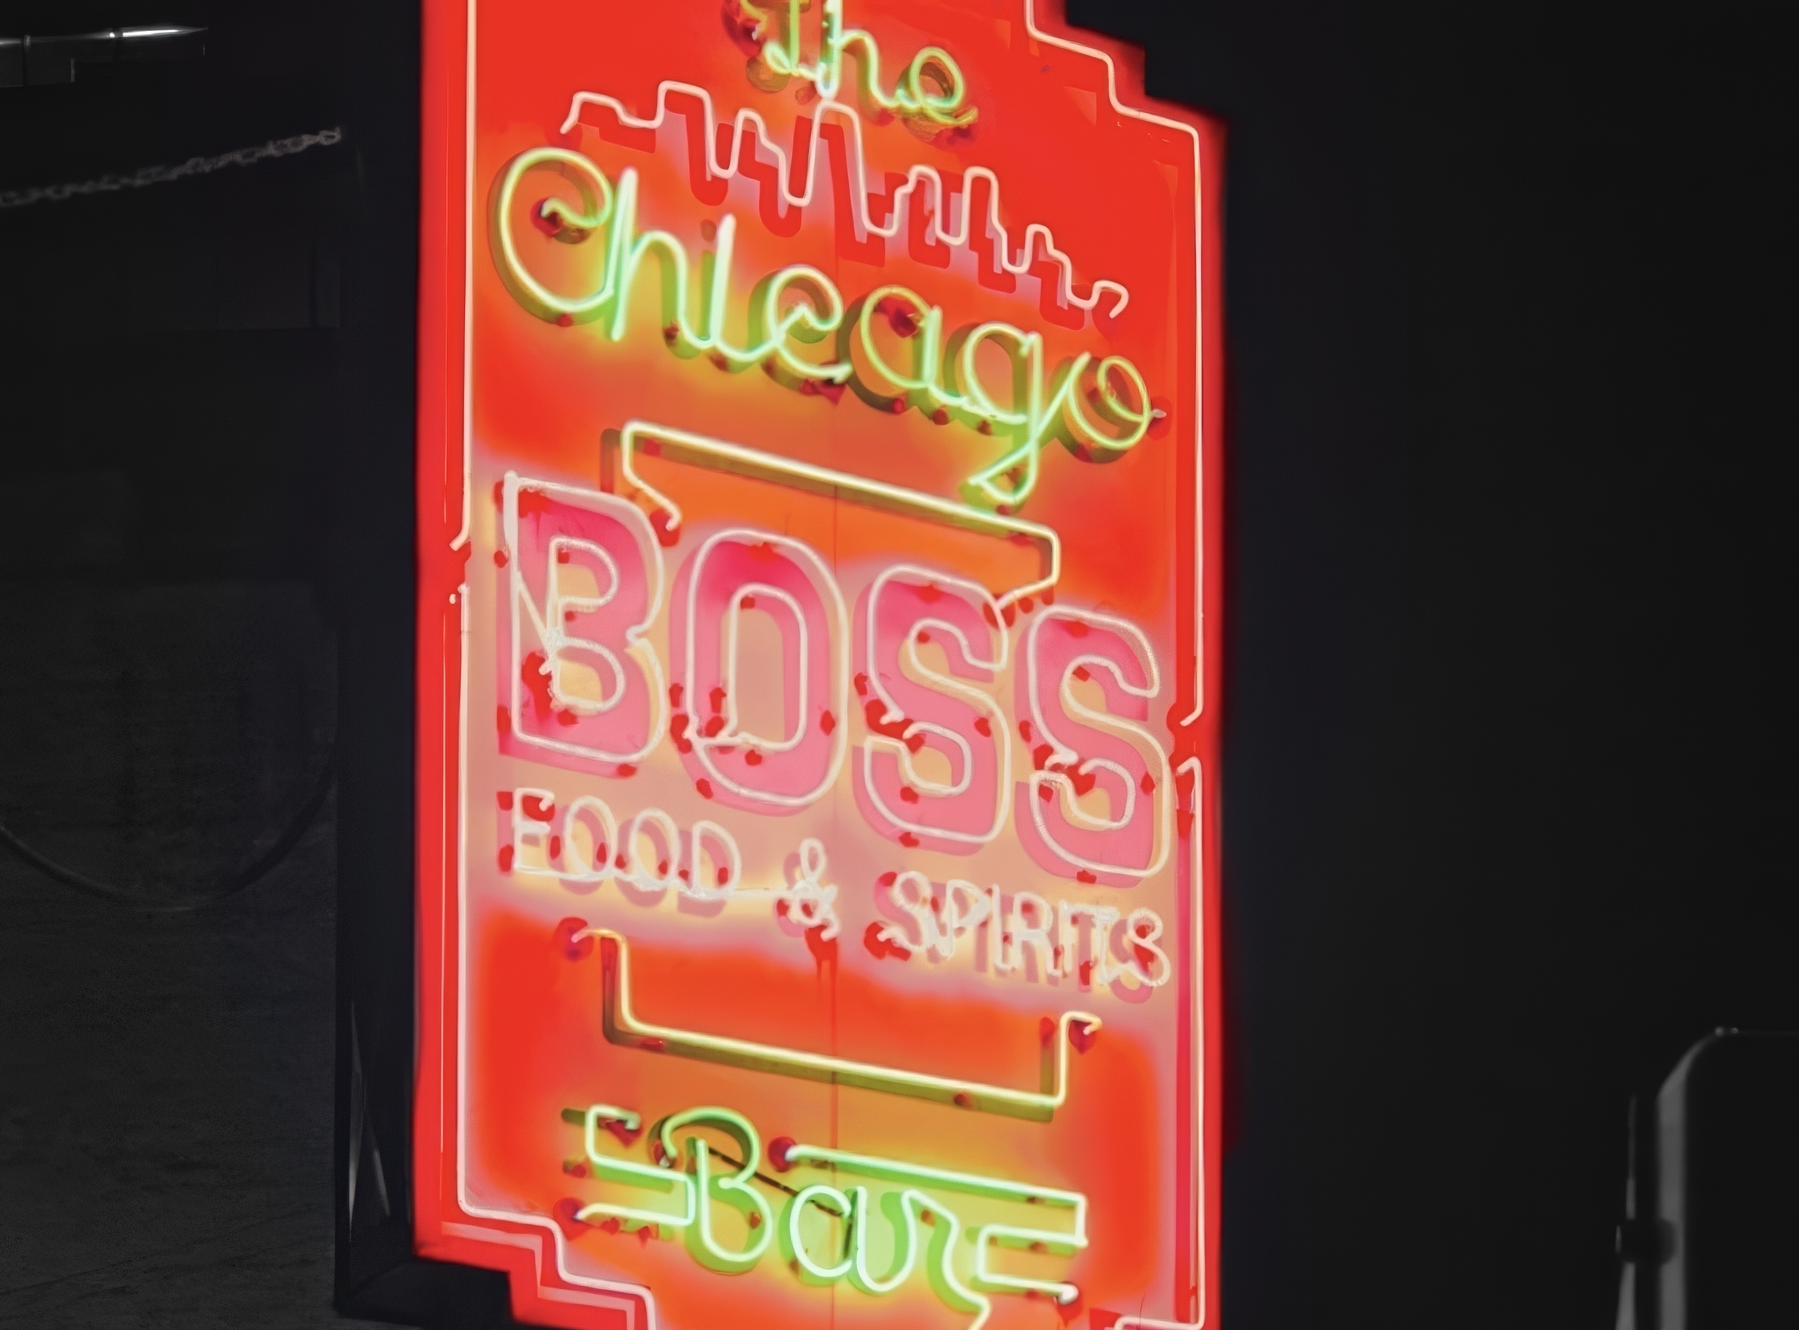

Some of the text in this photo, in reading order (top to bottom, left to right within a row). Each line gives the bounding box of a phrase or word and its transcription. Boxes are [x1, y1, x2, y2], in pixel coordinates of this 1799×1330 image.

[488, 147, 1165, 512] Chicago
[495, 470, 1171, 886] BOSS
[498, 787, 1171, 1004] FOOD & SPIRITS
